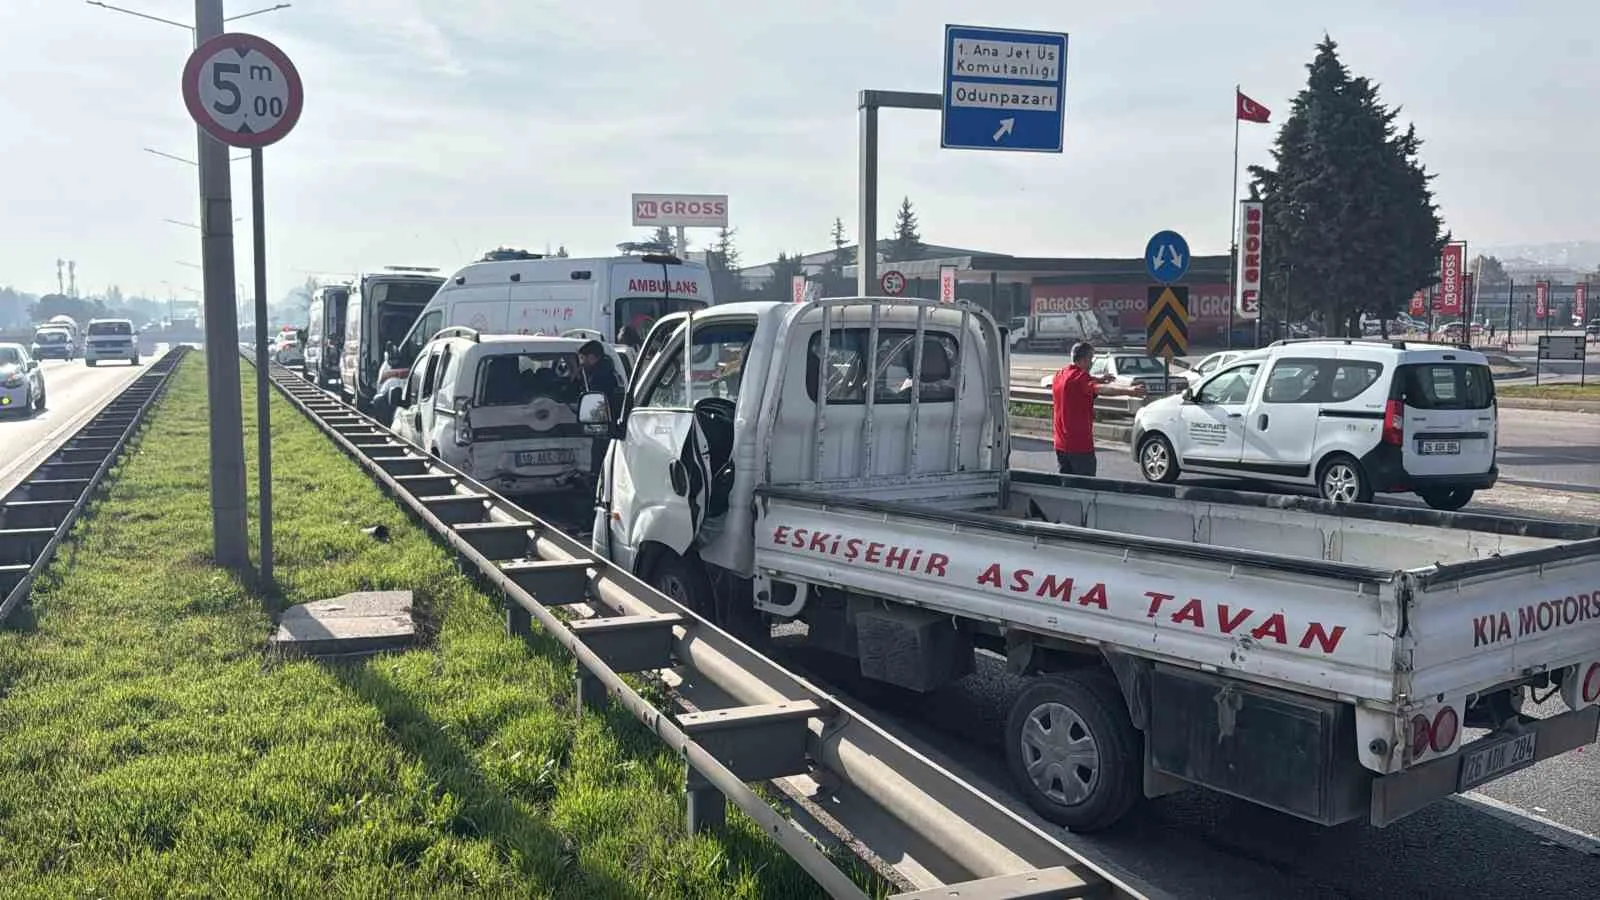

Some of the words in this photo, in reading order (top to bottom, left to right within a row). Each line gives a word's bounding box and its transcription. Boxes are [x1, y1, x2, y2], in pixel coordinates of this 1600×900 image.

[958, 43, 968, 56] 1.
[973, 44, 999, 57] Ana
[1005, 45, 1030, 59] Jet
[213, 62, 241, 115] 5
[250, 65, 272, 81] m
[955, 87, 1053, 107] Odunpazarı
[637, 201, 657, 218] XL
[661, 201, 725, 215] GROSS
[1245, 208, 1261, 283] GROSS
[628, 279, 698, 295] AMBULANS
[1444, 254, 1457, 291] GROSS
[976, 563, 1109, 610] ASMA
[1143, 591, 1347, 654] TAVAN
[1472, 611, 1512, 648] KIA
[1518, 590, 1600, 637] MOTORS
